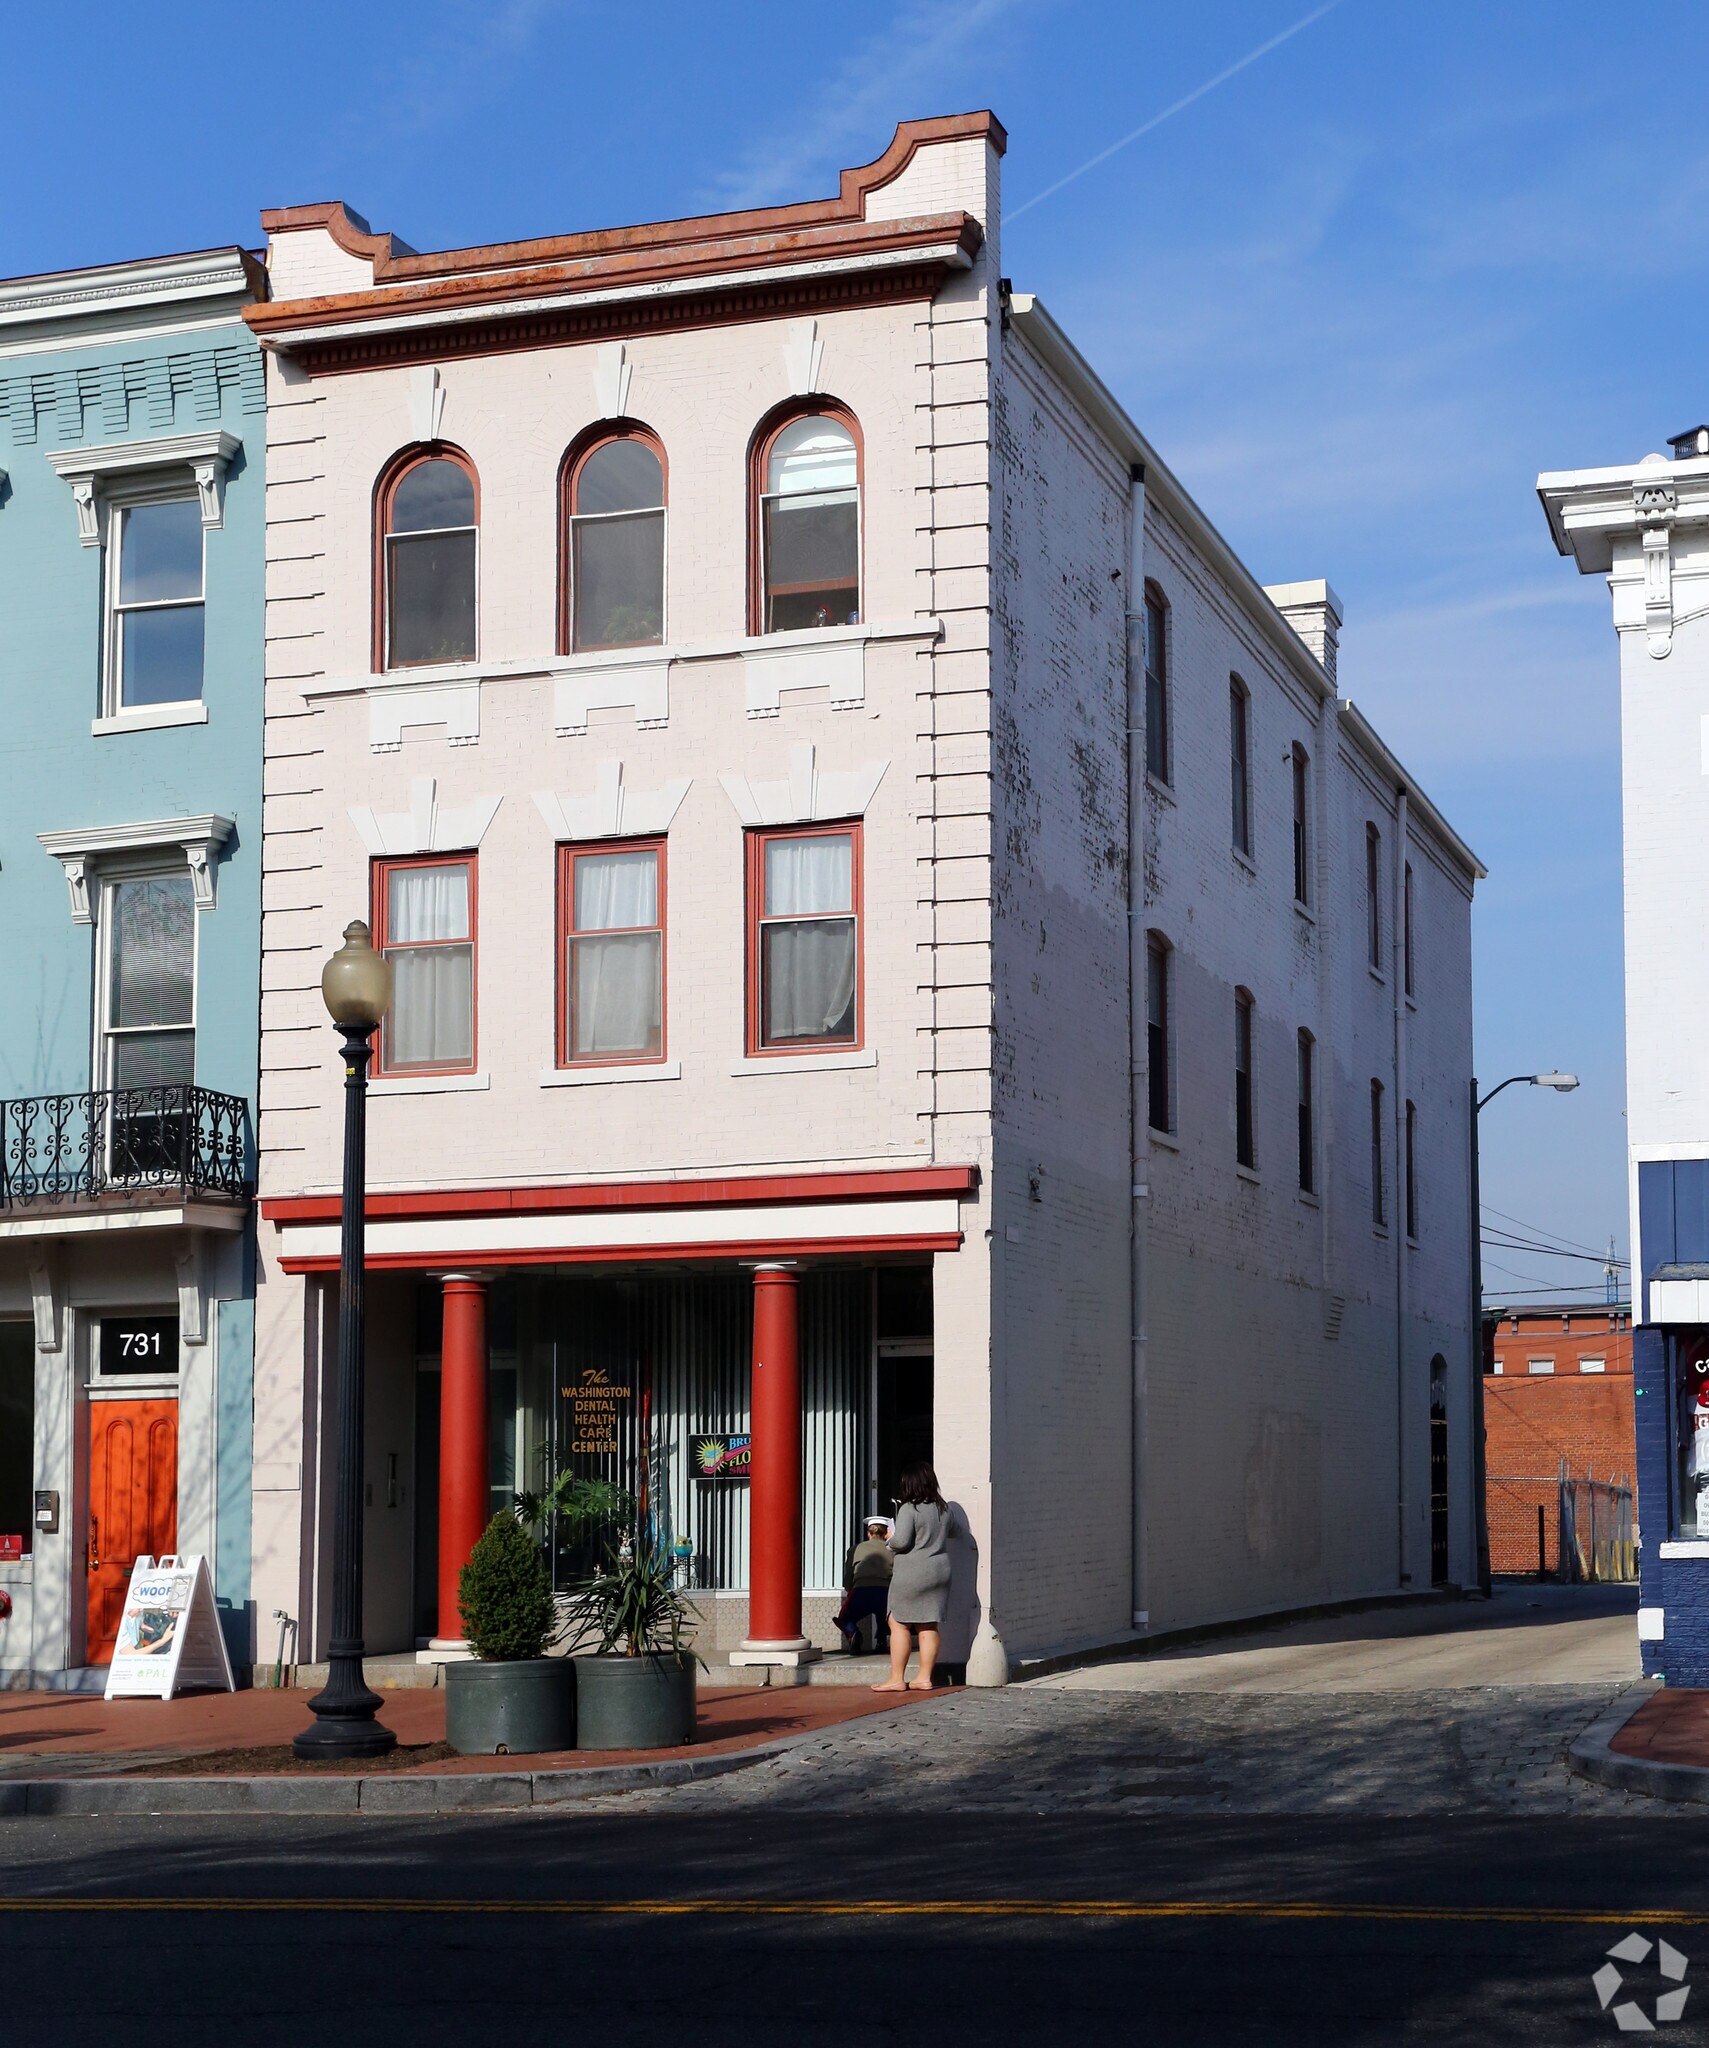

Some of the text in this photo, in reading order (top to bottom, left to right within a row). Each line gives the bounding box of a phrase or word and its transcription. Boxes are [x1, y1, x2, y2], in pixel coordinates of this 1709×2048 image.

[120, 1332, 160, 1356] 731
[582, 1368, 610, 1386] The
[561, 1386, 631, 1398] WASHINGTON
[575, 1400, 616, 1412] DENTAL
[574, 1413, 616, 1425] HEALTH
[579, 1427, 612, 1439] CARE
[571, 1441, 618, 1453] CENTER
